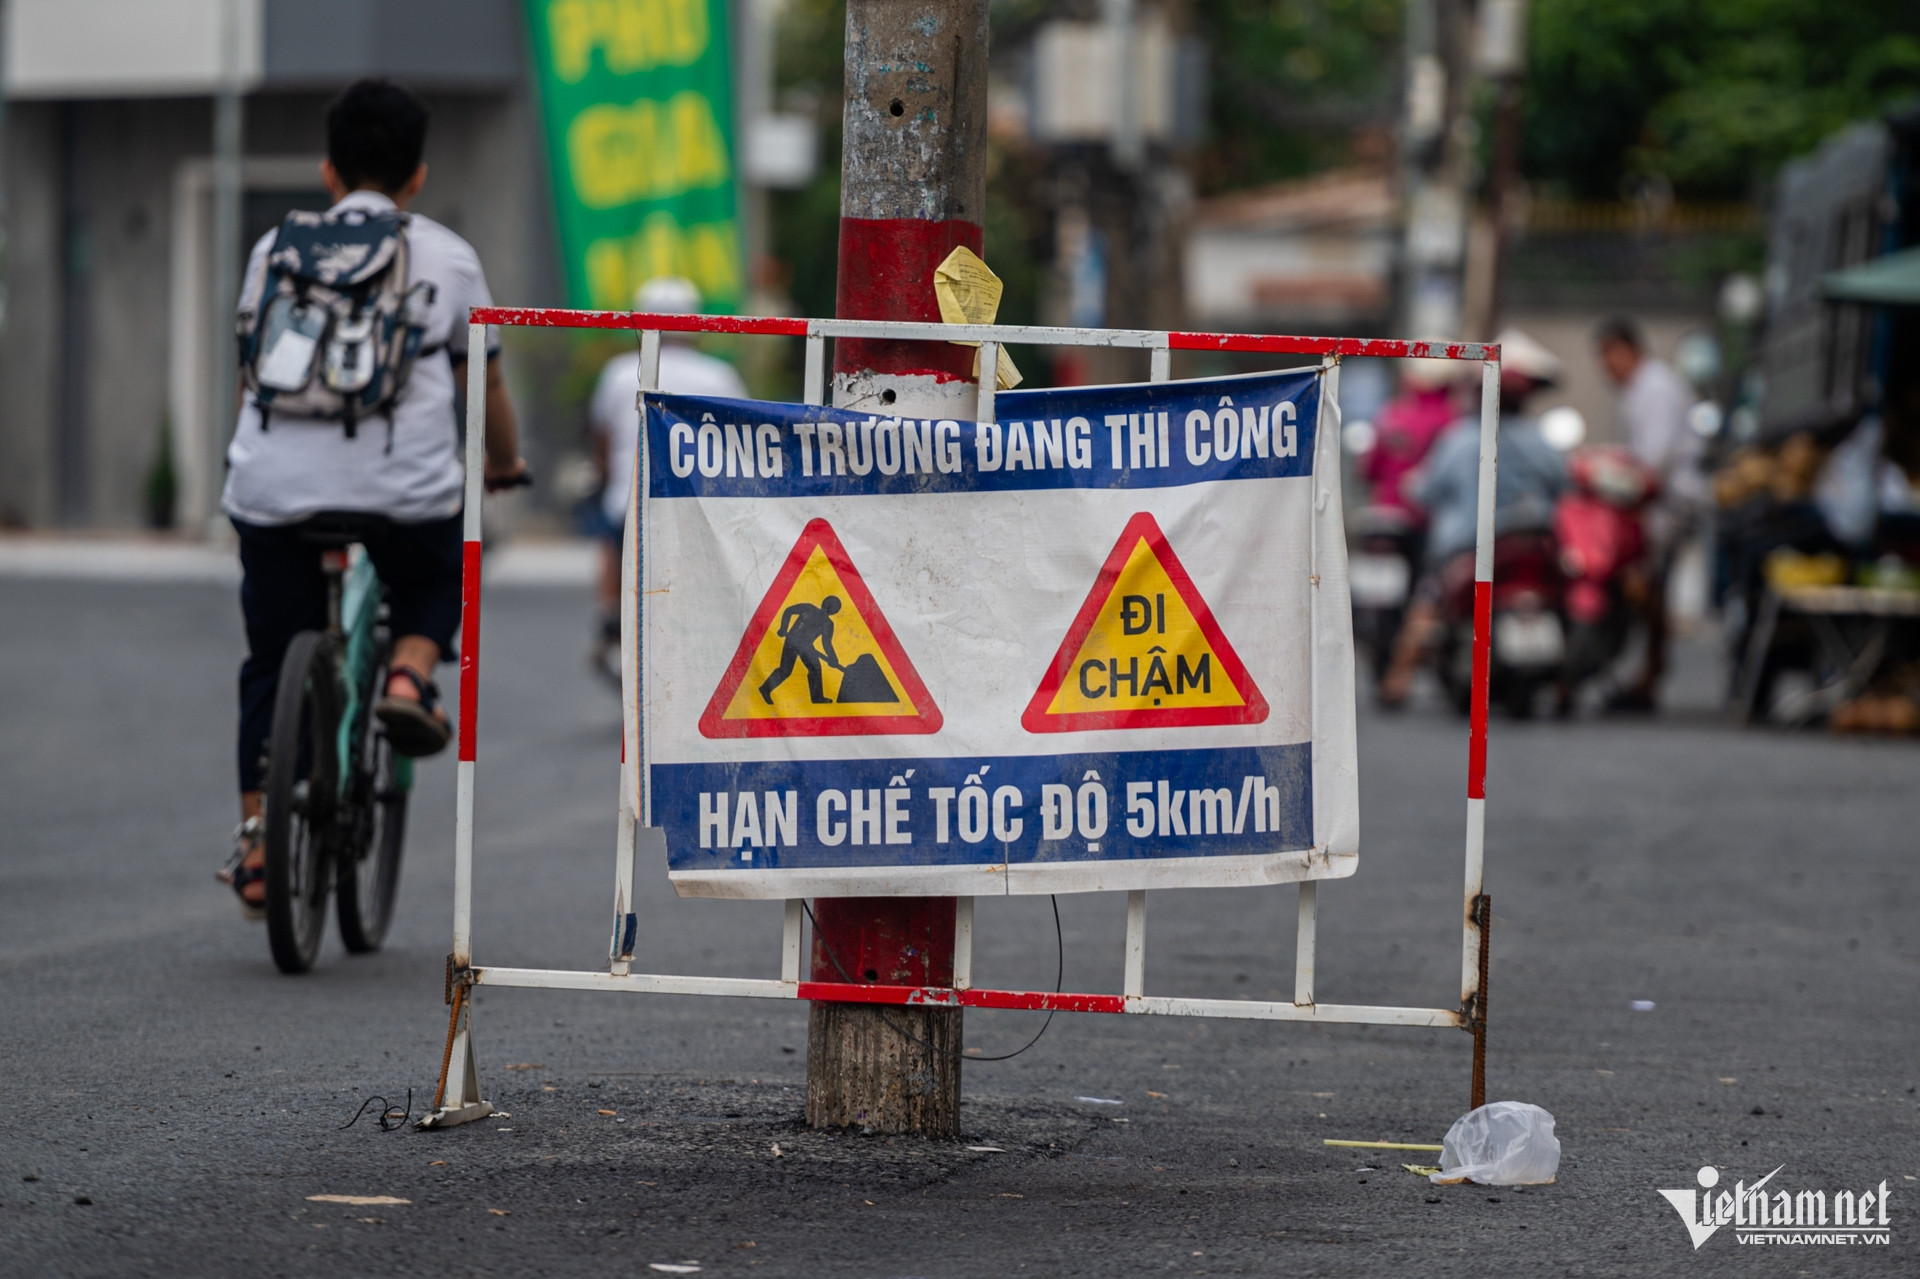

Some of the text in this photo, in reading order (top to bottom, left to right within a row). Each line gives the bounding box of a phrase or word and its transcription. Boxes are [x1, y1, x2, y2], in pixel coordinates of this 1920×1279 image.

[669, 396, 1298, 479] CÔNG TRƯỜNG ĐANG THI CÔNG
[1120, 593, 1166, 636] ĐI
[1079, 645, 1212, 706] CHẬM
[699, 765, 1281, 861] HẠN CHẾ TỐC ĐỘ 5km/h
